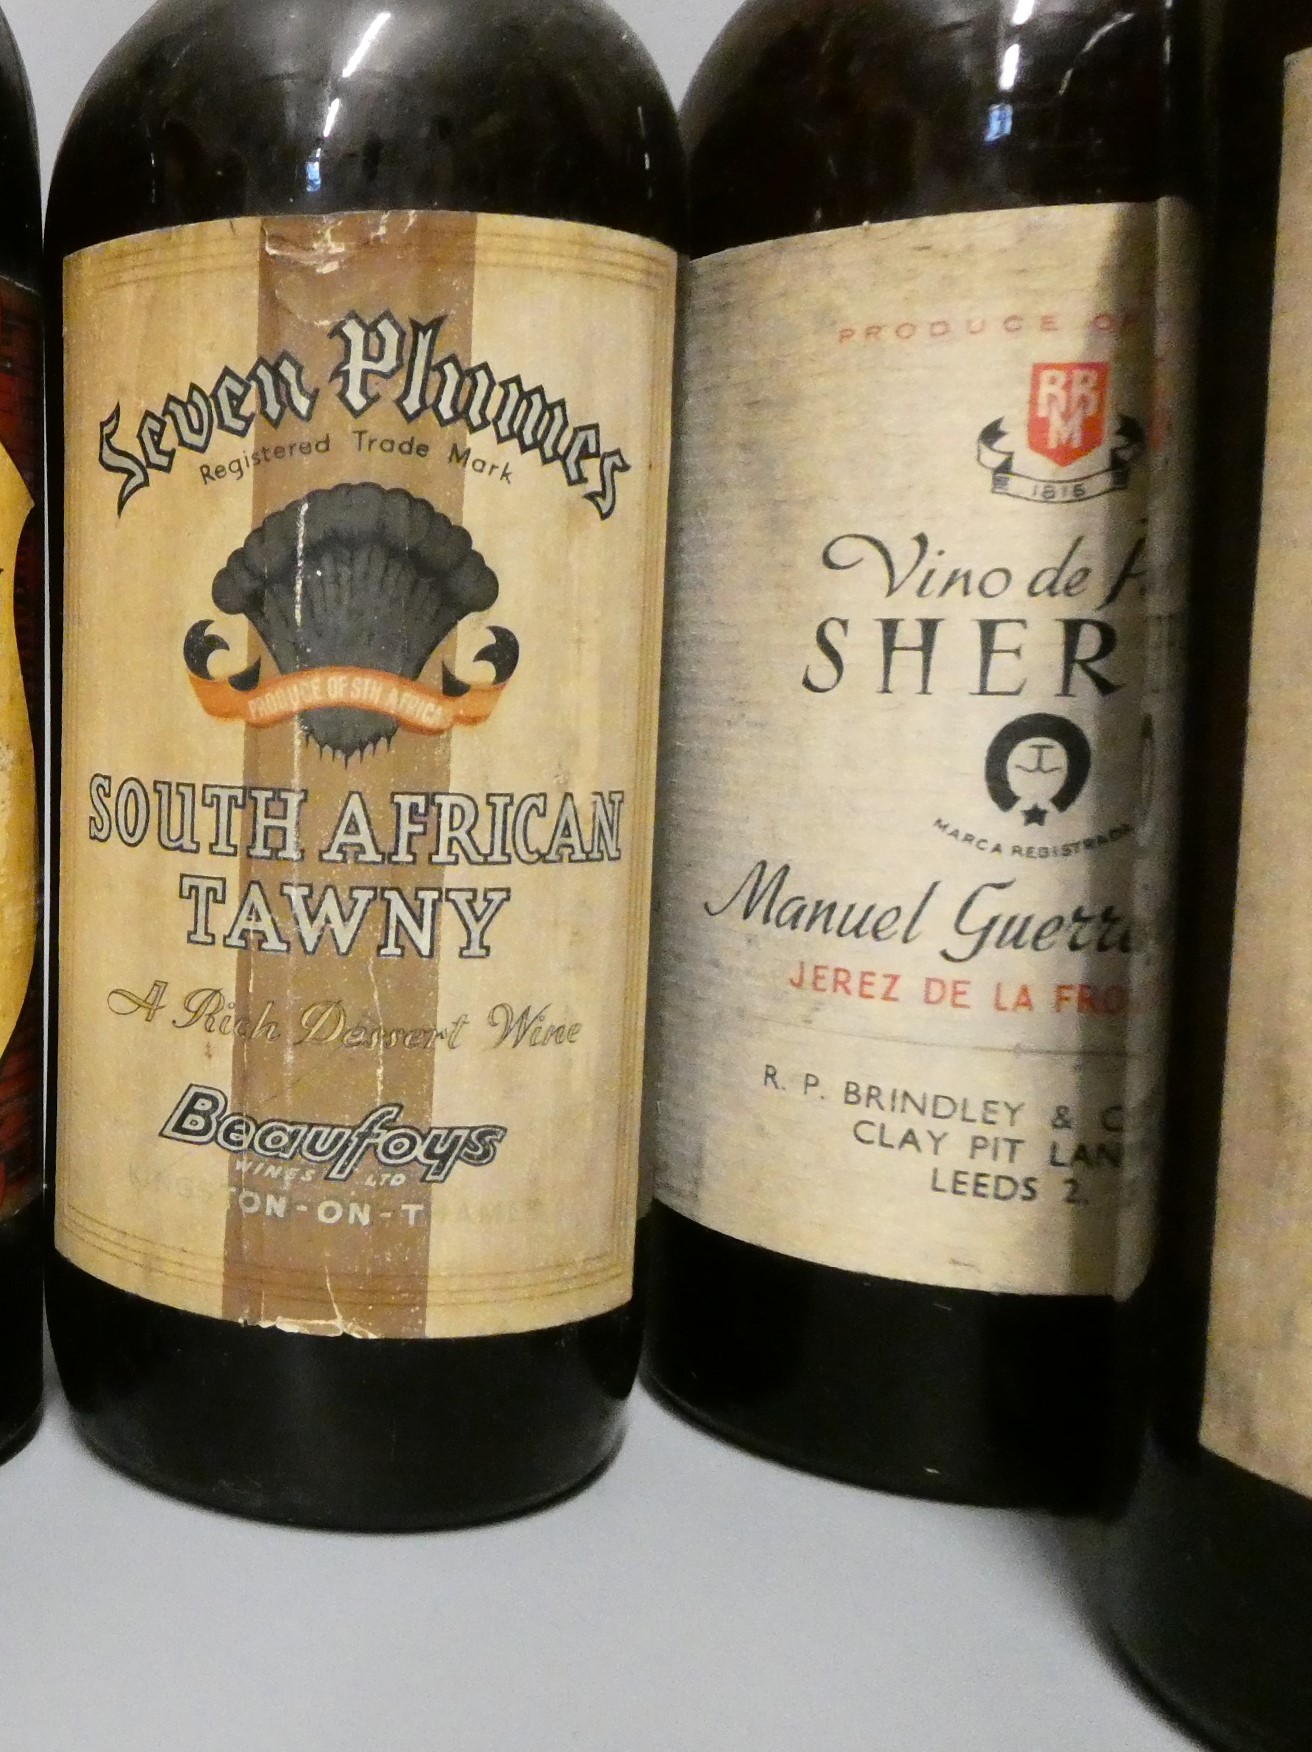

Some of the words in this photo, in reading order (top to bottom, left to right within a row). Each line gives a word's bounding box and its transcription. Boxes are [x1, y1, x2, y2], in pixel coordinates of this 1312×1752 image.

[838, 312, 1059, 344] PRODUCE
[98, 349, 320, 519] Seven
[327, 308, 632, 521] Plumes
[200, 432, 331, 485] Registered
[353, 429, 430, 459] Trade
[449, 441, 514, 484] Mark
[821, 531, 1013, 599] Vino
[1026, 535, 1091, 599] de
[801, 616, 1126, 699] SHER
[87, 773, 310, 863] SOUTH
[320, 790, 626, 865] AFRICAN
[932, 818, 1003, 856] MARCA
[180, 873, 511, 960] TAWNY
[704, 858, 941, 945] Manuel
[106, 980, 167, 1023] A
[171, 986, 283, 1046] Rich
[299, 1000, 470, 1051] Dessert
[487, 1001, 582, 1050] Wine
[789, 961, 901, 1002] JEREZ
[923, 976, 972, 1010] DE
[994, 982, 1034, 1014] LA
[1053, 983, 1129, 1017] FRO
[763, 1064, 786, 1089] R.
[803, 1073, 825, 1101] P.
[843, 1081, 1025, 1129] BRINDLEY
[1050, 1105, 1073, 1131] &
[159, 1083, 508, 1184] Beaufoys
[853, 1119, 948, 1157] CLAY
[970, 1134, 1025, 1163] PIT
[1049, 1141, 1124, 1170] LAN
[234, 1158, 315, 1184] WINES
[365, 1171, 406, 1188] LTD
[931, 1167, 1038, 1202] LEEDS
